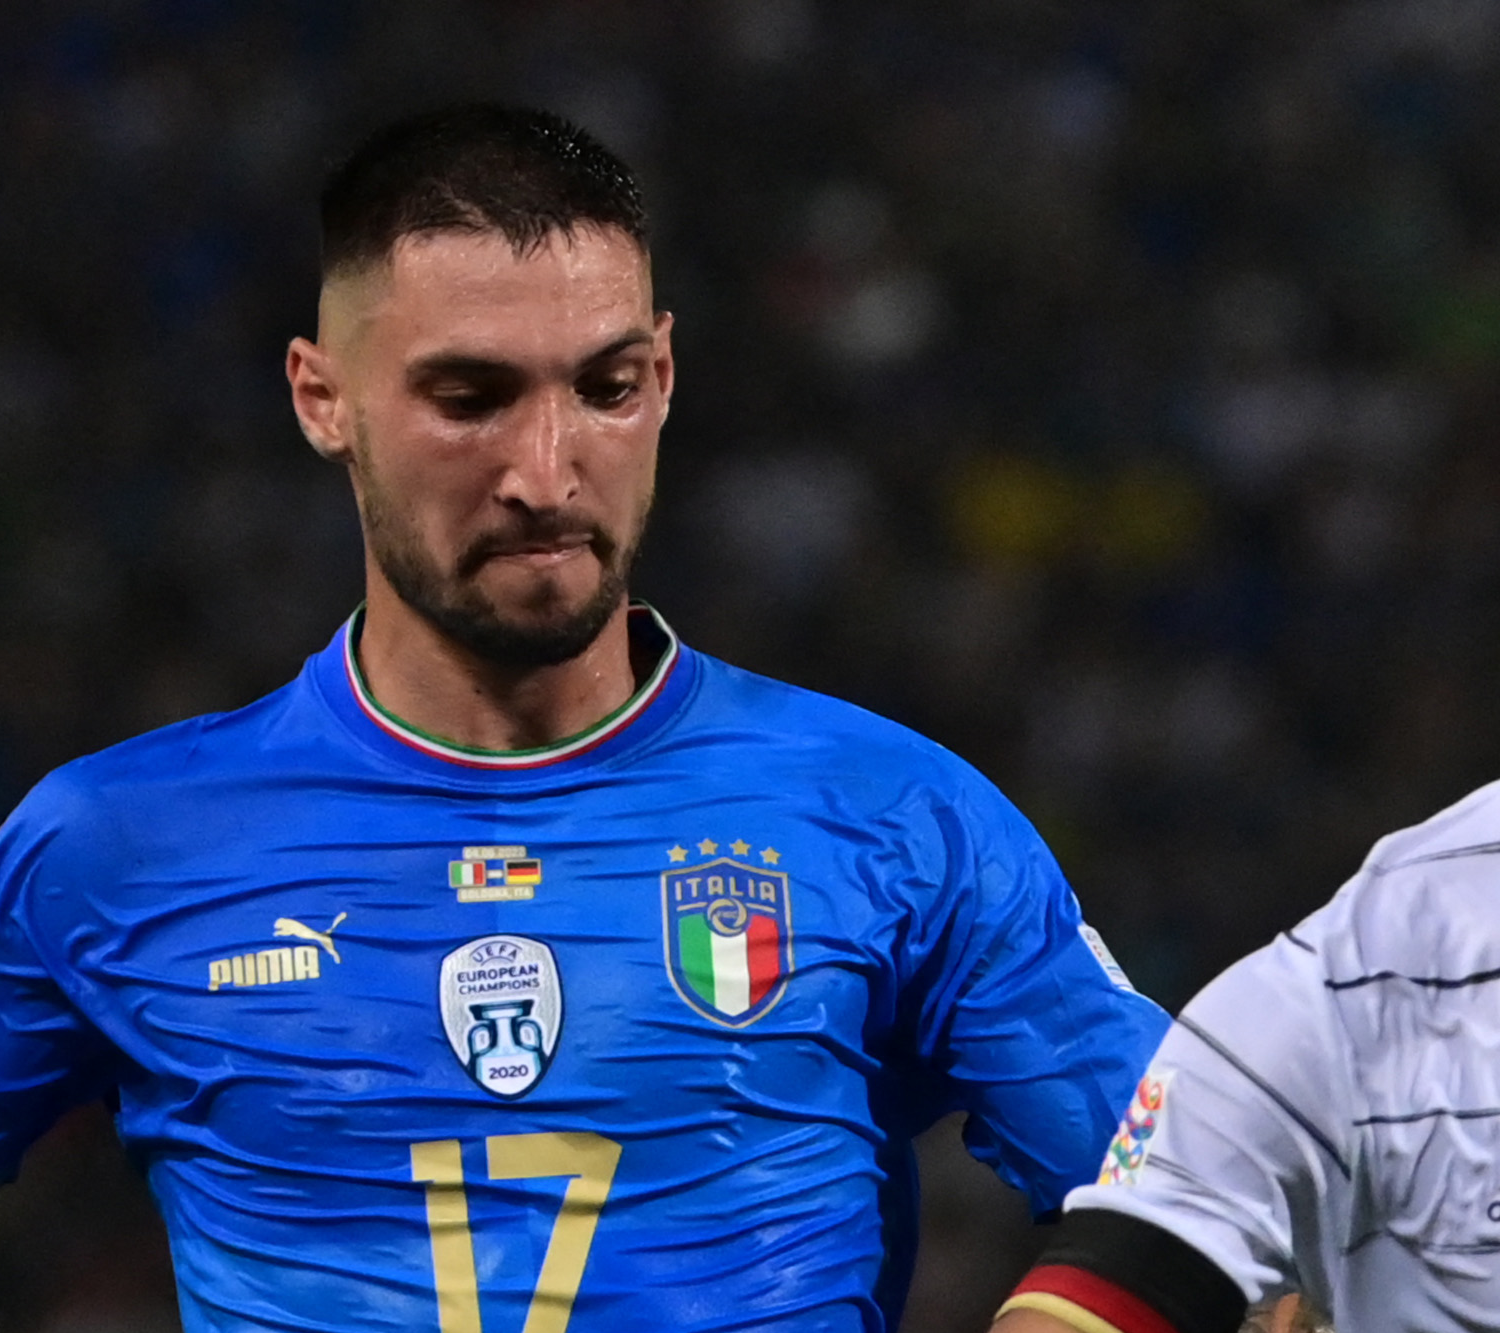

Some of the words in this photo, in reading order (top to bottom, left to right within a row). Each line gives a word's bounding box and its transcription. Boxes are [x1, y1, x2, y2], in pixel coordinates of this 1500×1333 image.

[675, 875, 777, 903] ITALIA
[472, 944, 518, 963] UEFA
[208, 945, 320, 991] PUMA
[457, 964, 539, 983] EUROPEAN
[458, 977, 540, 995] CHAMPIONS
[488, 1065, 529, 1079] 2020
